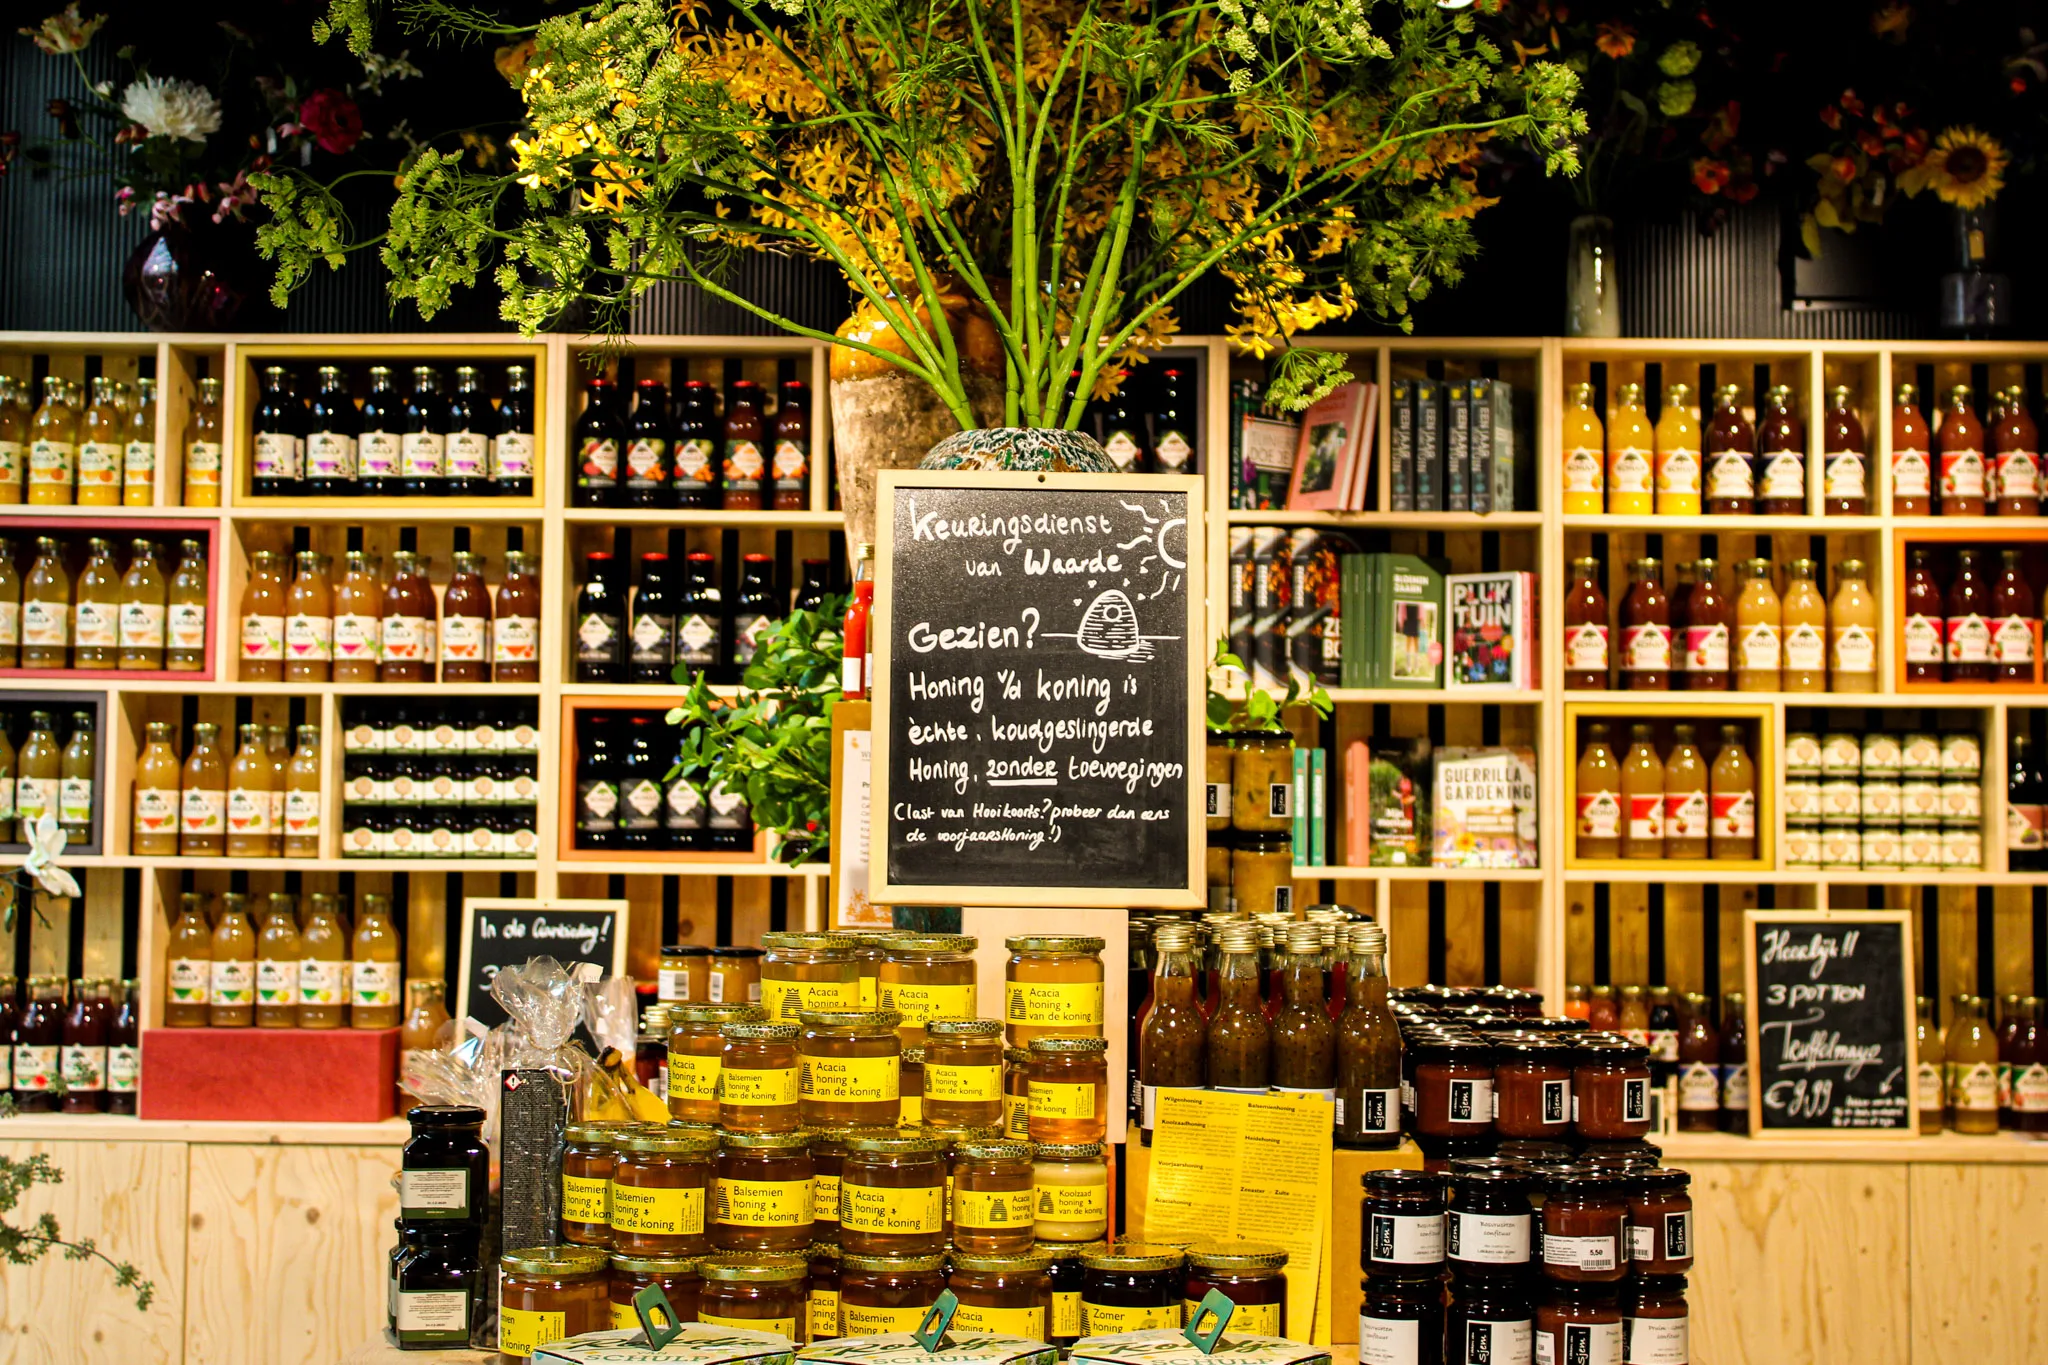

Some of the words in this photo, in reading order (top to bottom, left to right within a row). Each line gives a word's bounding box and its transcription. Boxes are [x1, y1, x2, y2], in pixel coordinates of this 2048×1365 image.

[965, 558, 1003, 578] van
[1023, 549, 1123, 576] Waarde
[1454, 581, 1511, 605] PLUK
[1454, 604, 1512, 628] TUIN
[908, 606, 1042, 653] Gezien?
[908, 670, 986, 714] Honing
[1037, 667, 1112, 717] koning
[1123, 677, 1139, 697] is
[991, 714, 1155, 754] koudgeslingerde
[1444, 766, 1522, 784] GUERRILLA
[1444, 784, 1532, 801] GARDENING
[941, 808, 966, 821] van
[1107, 803, 1137, 821] dan
[1140, 809, 1171, 822] eens
[906, 827, 928, 843] de
[480, 916, 497, 939] In
[808, 986, 839, 997] Acacia
[899, 989, 929, 999] Acacia
[1029, 987, 1060, 998] Acacia
[1766, 984, 1788, 1006] 3
[899, 1001, 930, 1013] honing
[1029, 999, 1061, 1012] honing
[916, 1012, 929, 1022] de
[1048, 1012, 1060, 1021] de
[1063, 1012, 1092, 1023] koning
[672, 1060, 695, 1070] Acacia
[816, 1062, 846, 1072] Acacia
[672, 1072, 696, 1084] honing
[728, 1072, 763, 1082] Balsemien
[936, 1069, 958, 1078] Acacia
[816, 1074, 848, 1086] honing
[936, 1078, 958, 1088] honing
[672, 1084, 684, 1092] van
[684, 1084, 695, 1094] de
[728, 1082, 750, 1092] honing
[816, 1088, 832, 1096] van
[833, 1086, 847, 1096] de
[849, 1086, 881, 1098] koning
[949, 1087, 958, 1095] de
[960, 1087, 983, 1096] koning
[728, 1092, 740, 1100] van
[740, 1092, 750, 1100] de
[751, 1092, 777, 1101] koning
[1044, 1104, 1067, 1115] koning
[568, 1181, 608, 1195] Balsemien
[734, 1186, 784, 1198] Balsemien
[568, 1196, 592, 1209] honing
[616, 1189, 656, 1204] Balsemien
[855, 1191, 885, 1203] Acacia
[734, 1200, 766, 1211] honing
[1059, 1198, 1084, 1208] honing
[567, 1208, 580, 1218] van
[581, 1208, 592, 1219] de
[615, 1204, 639, 1217] honing
[814, 1206, 829, 1215] van
[855, 1203, 886, 1217] honing
[733, 1212, 749, 1221] van
[752, 1211, 765, 1222] de
[768, 1212, 799, 1224] koning
[855, 1216, 869, 1226] van
[872, 1216, 884, 1227] de
[888, 1218, 921, 1230] koning
[615, 1216, 626, 1227] van
[628, 1216, 638, 1228] de
[640, 1218, 675, 1232] koning
[814, 1296, 835, 1307] cacia
[813, 1310, 836, 1322] oning
[850, 1310, 895, 1324] Balsemien
[956, 1310, 983, 1322] Acacia
[1093, 1308, 1126, 1322] Zomer
[822, 1322, 835, 1331] de
[850, 1324, 878, 1335] honing
[956, 1322, 984, 1333] honing
[1093, 1320, 1124, 1334] honing
[506, 1340, 531, 1354] koning
[583, 1354, 712, 1363] SCHULP
[872, 1354, 998, 1364] SCHULP
